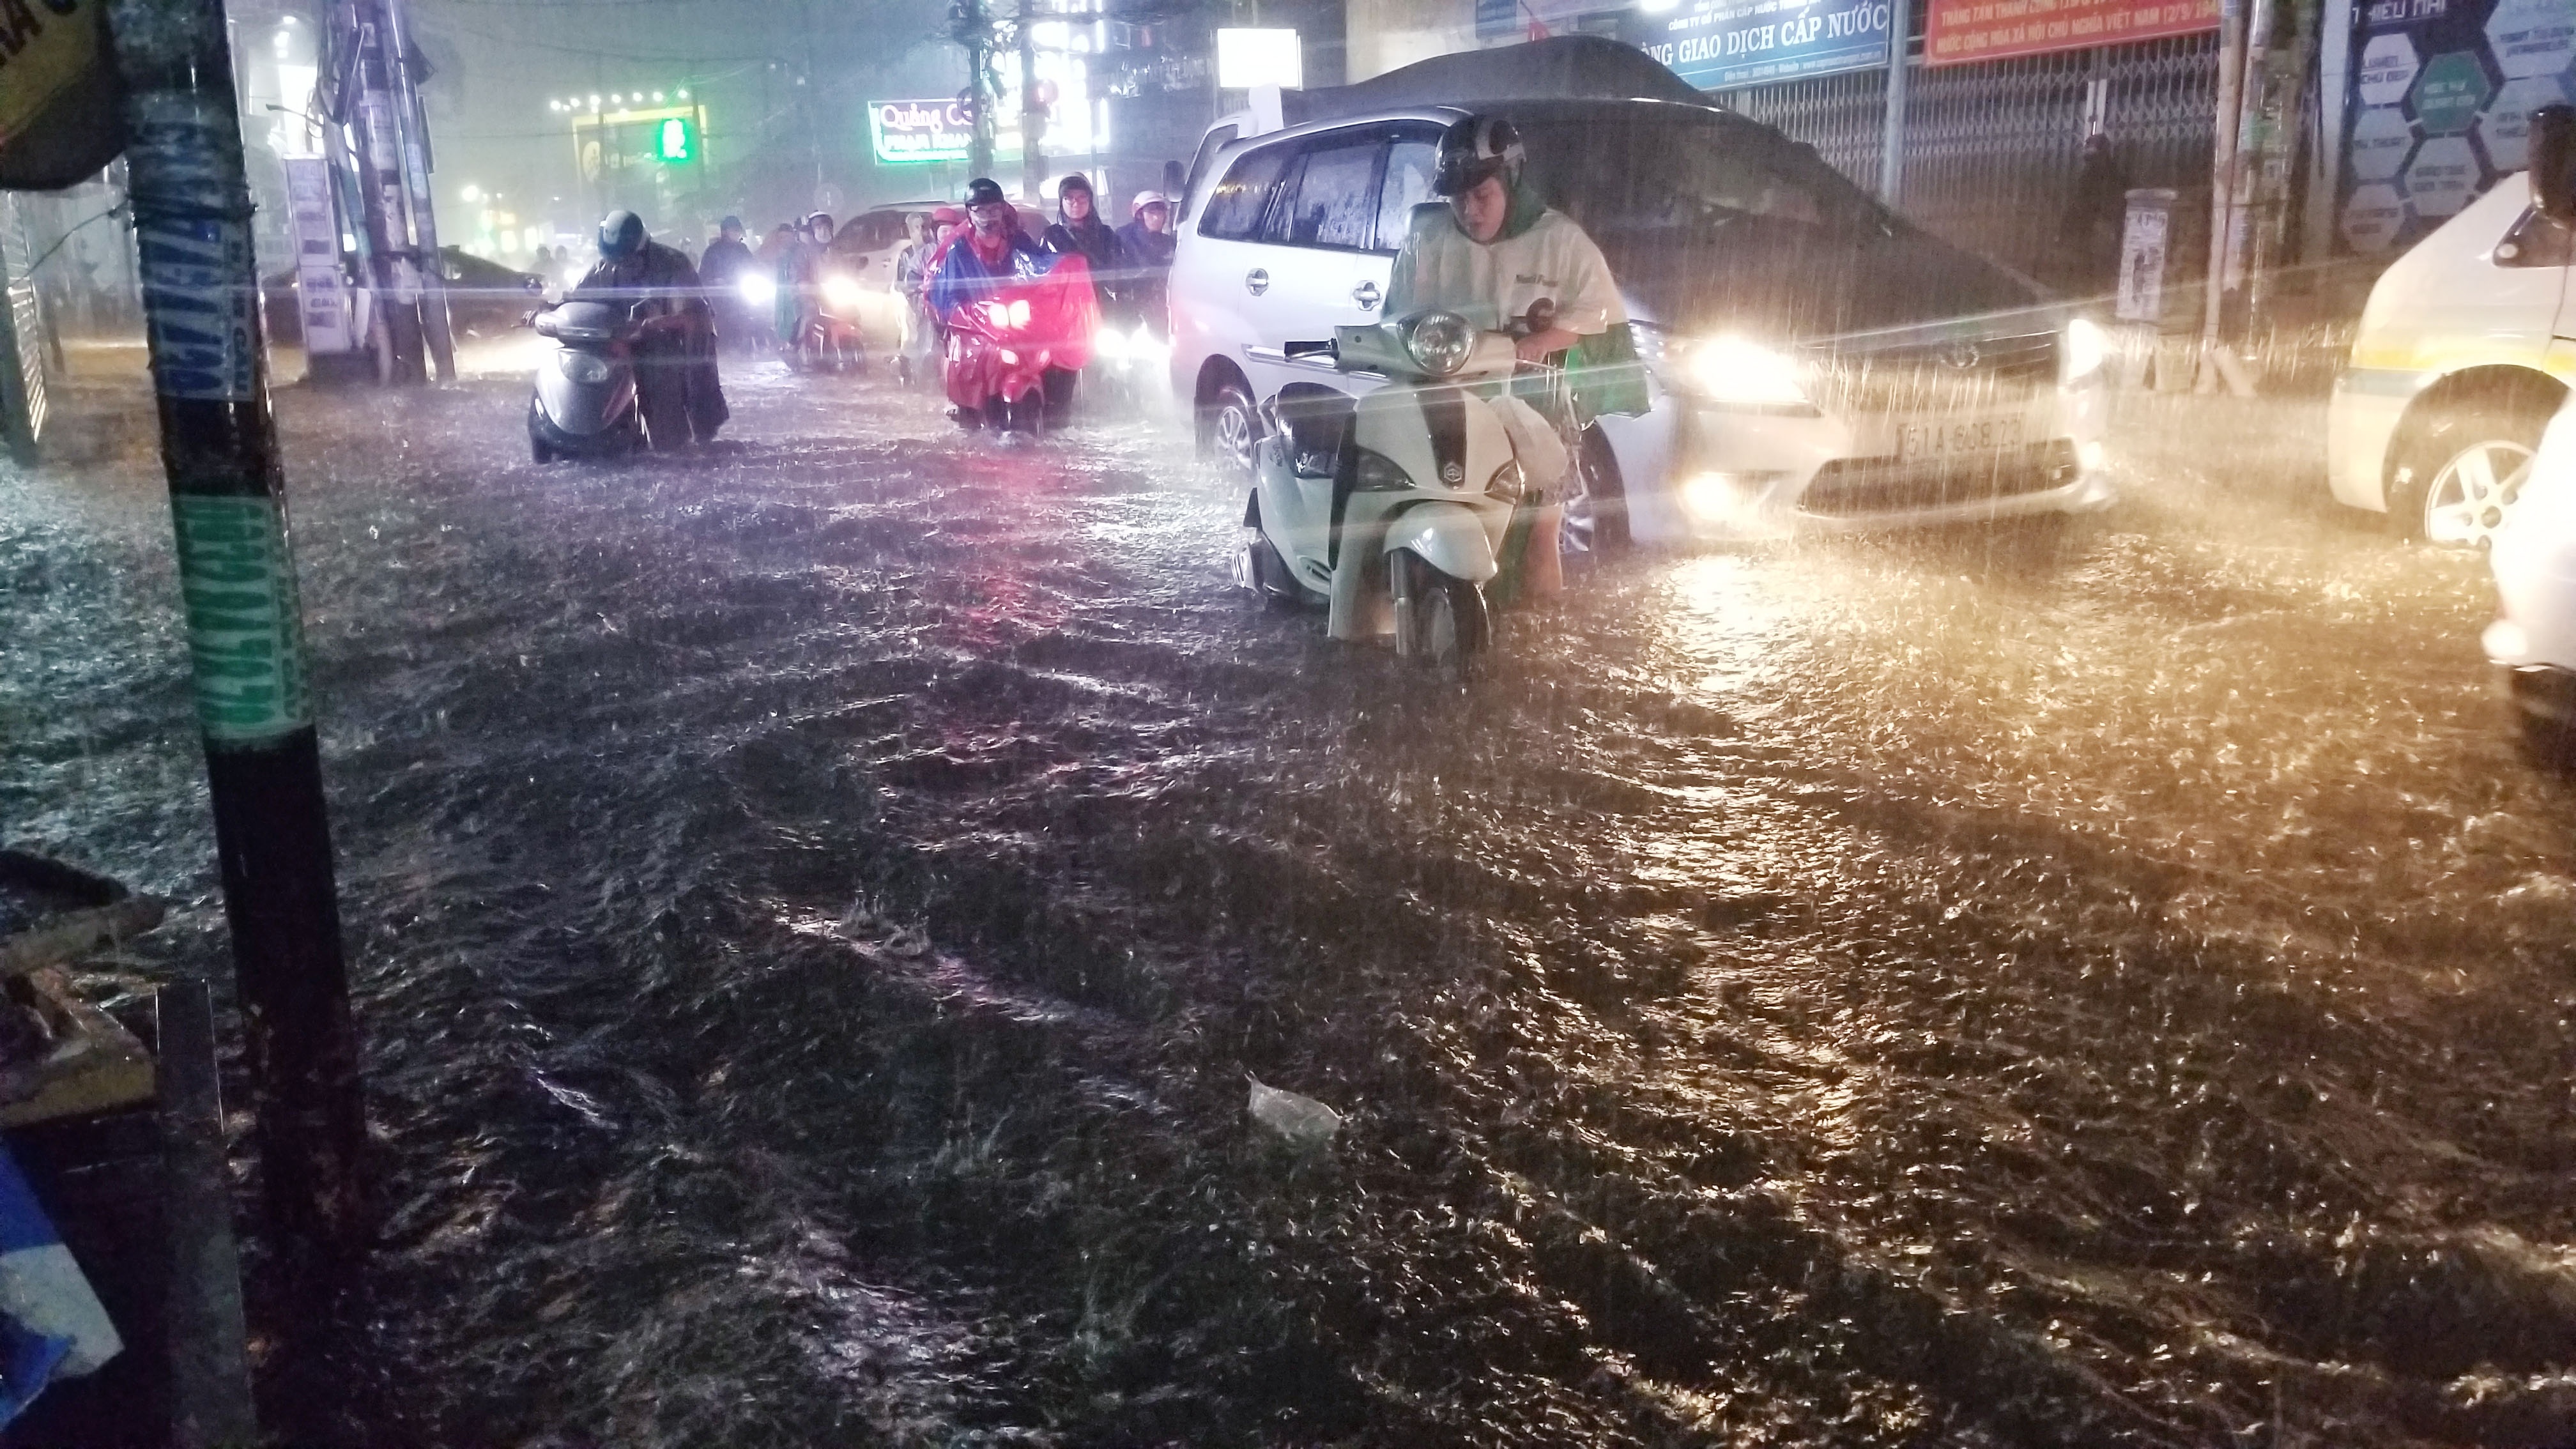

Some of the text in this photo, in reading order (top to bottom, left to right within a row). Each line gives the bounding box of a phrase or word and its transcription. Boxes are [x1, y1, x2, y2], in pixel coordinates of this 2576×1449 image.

[1678, 34, 1721, 63] GIAO
[1726, 24, 1775, 59] DỊCH
[1781, 6, 1822, 46] CẤP
[1827, 0, 1887, 38] NƯỚC
[880, 102, 944, 134] Quảng
